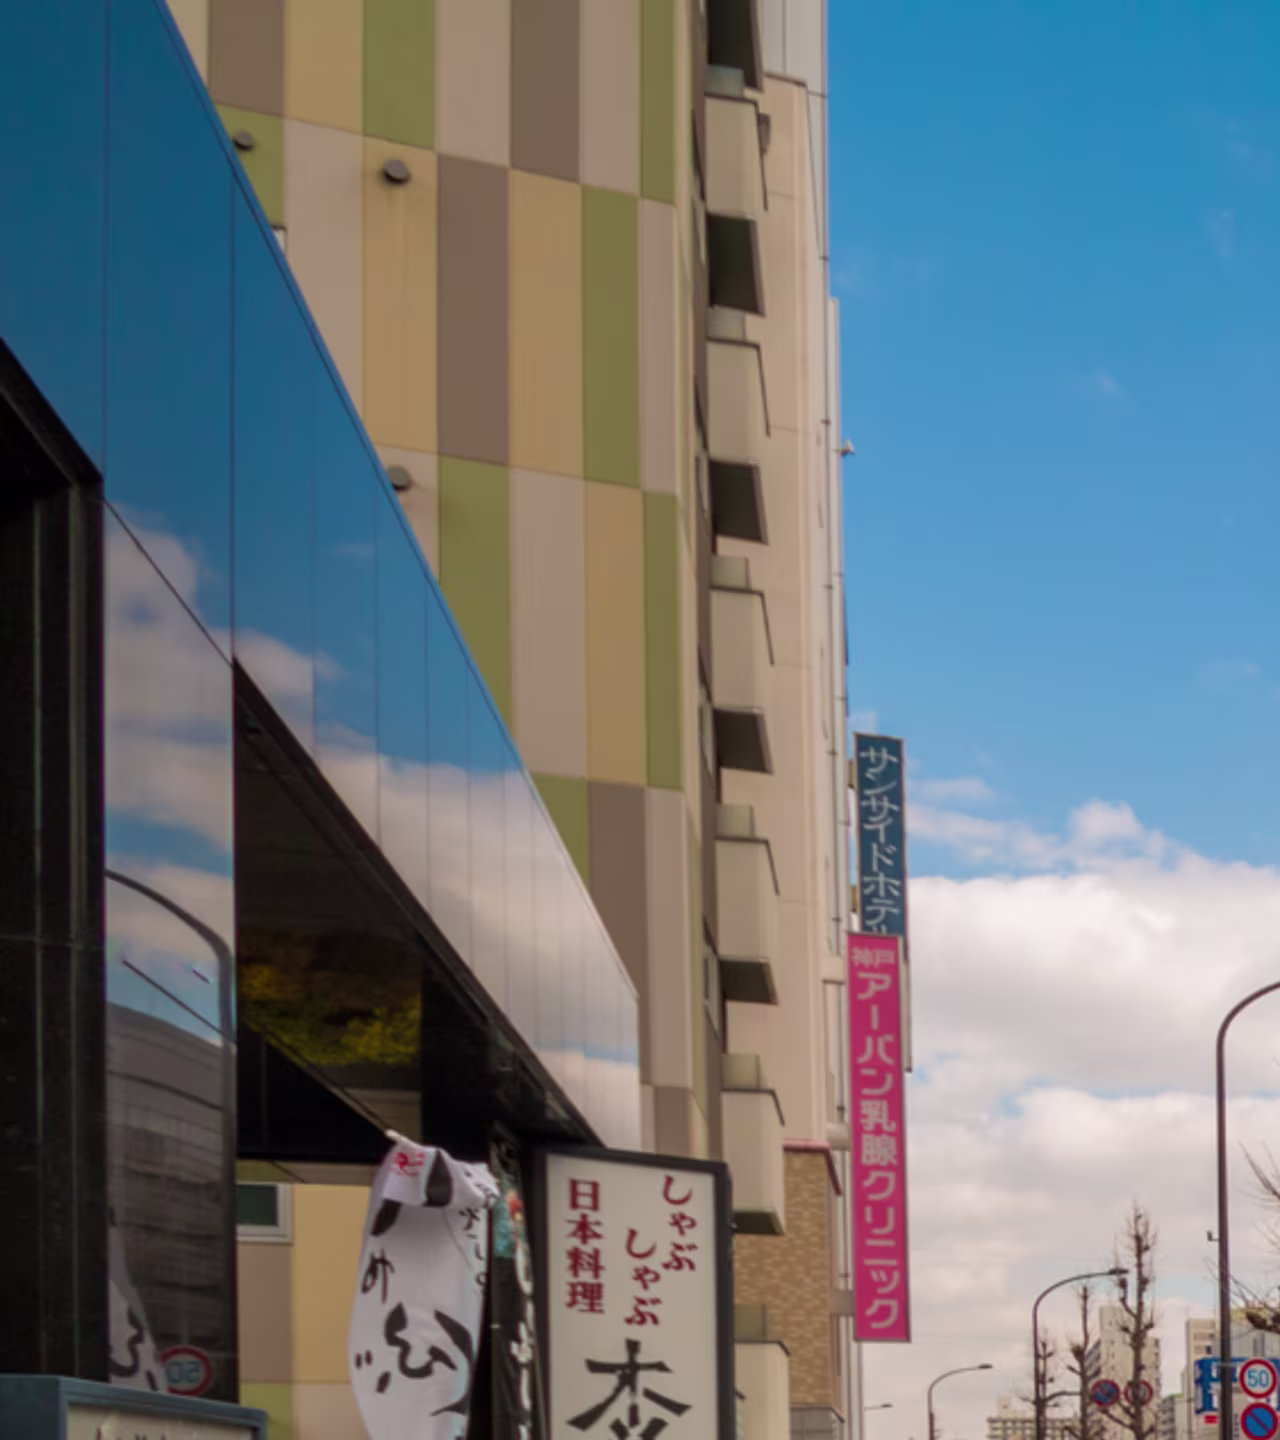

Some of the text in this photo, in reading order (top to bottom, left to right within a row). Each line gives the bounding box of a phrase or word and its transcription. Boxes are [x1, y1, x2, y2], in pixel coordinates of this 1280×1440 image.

[851, 947, 900, 1329] 神戸 アーバン乳腺クリニック
[565, 1178, 605, 1315] 日本料理
[624, 1174, 698, 1326] しゃぶ しゃぶ
[1247, 1369, 1269, 1388] 50
